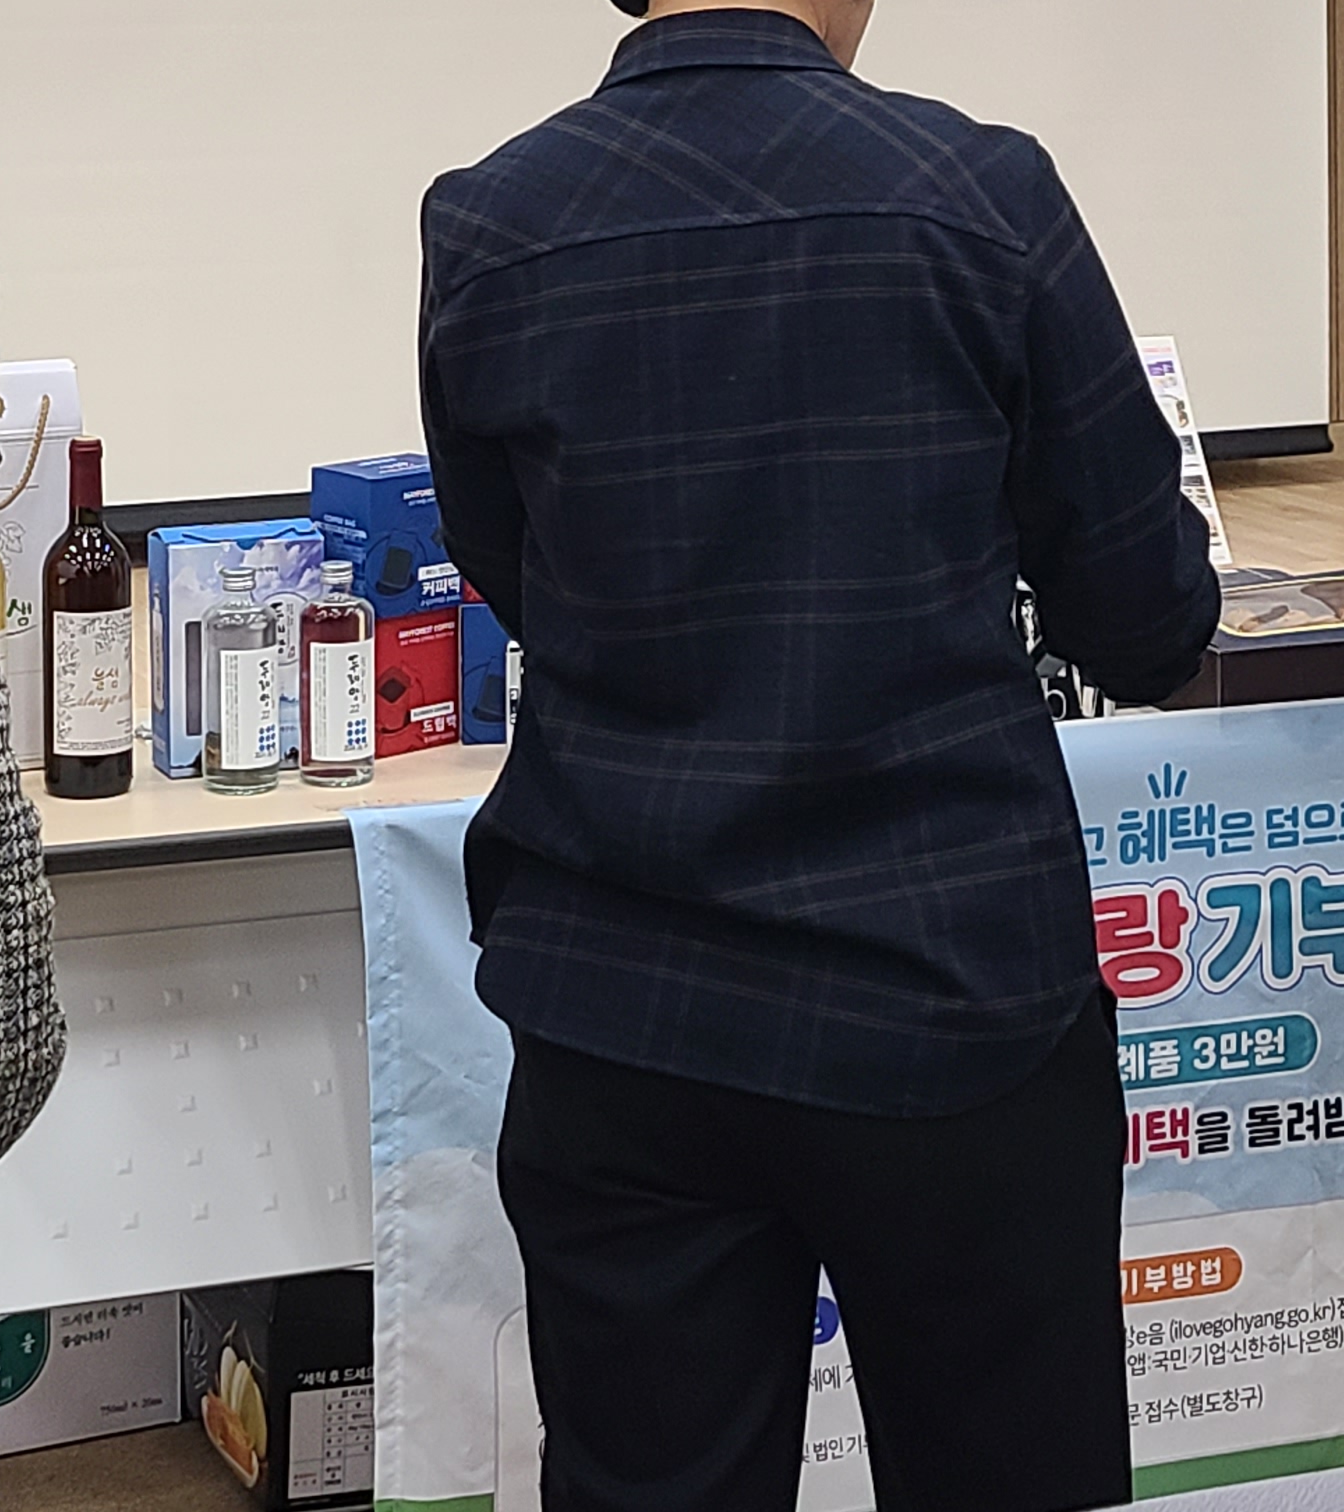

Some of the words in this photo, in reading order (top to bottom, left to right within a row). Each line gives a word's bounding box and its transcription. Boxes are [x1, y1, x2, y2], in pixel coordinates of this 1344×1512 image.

[421, 575, 461, 597] 커피백
[1117, 804, 1255, 865] 혜택은
[1193, 1025, 1286, 1070] 3만원
